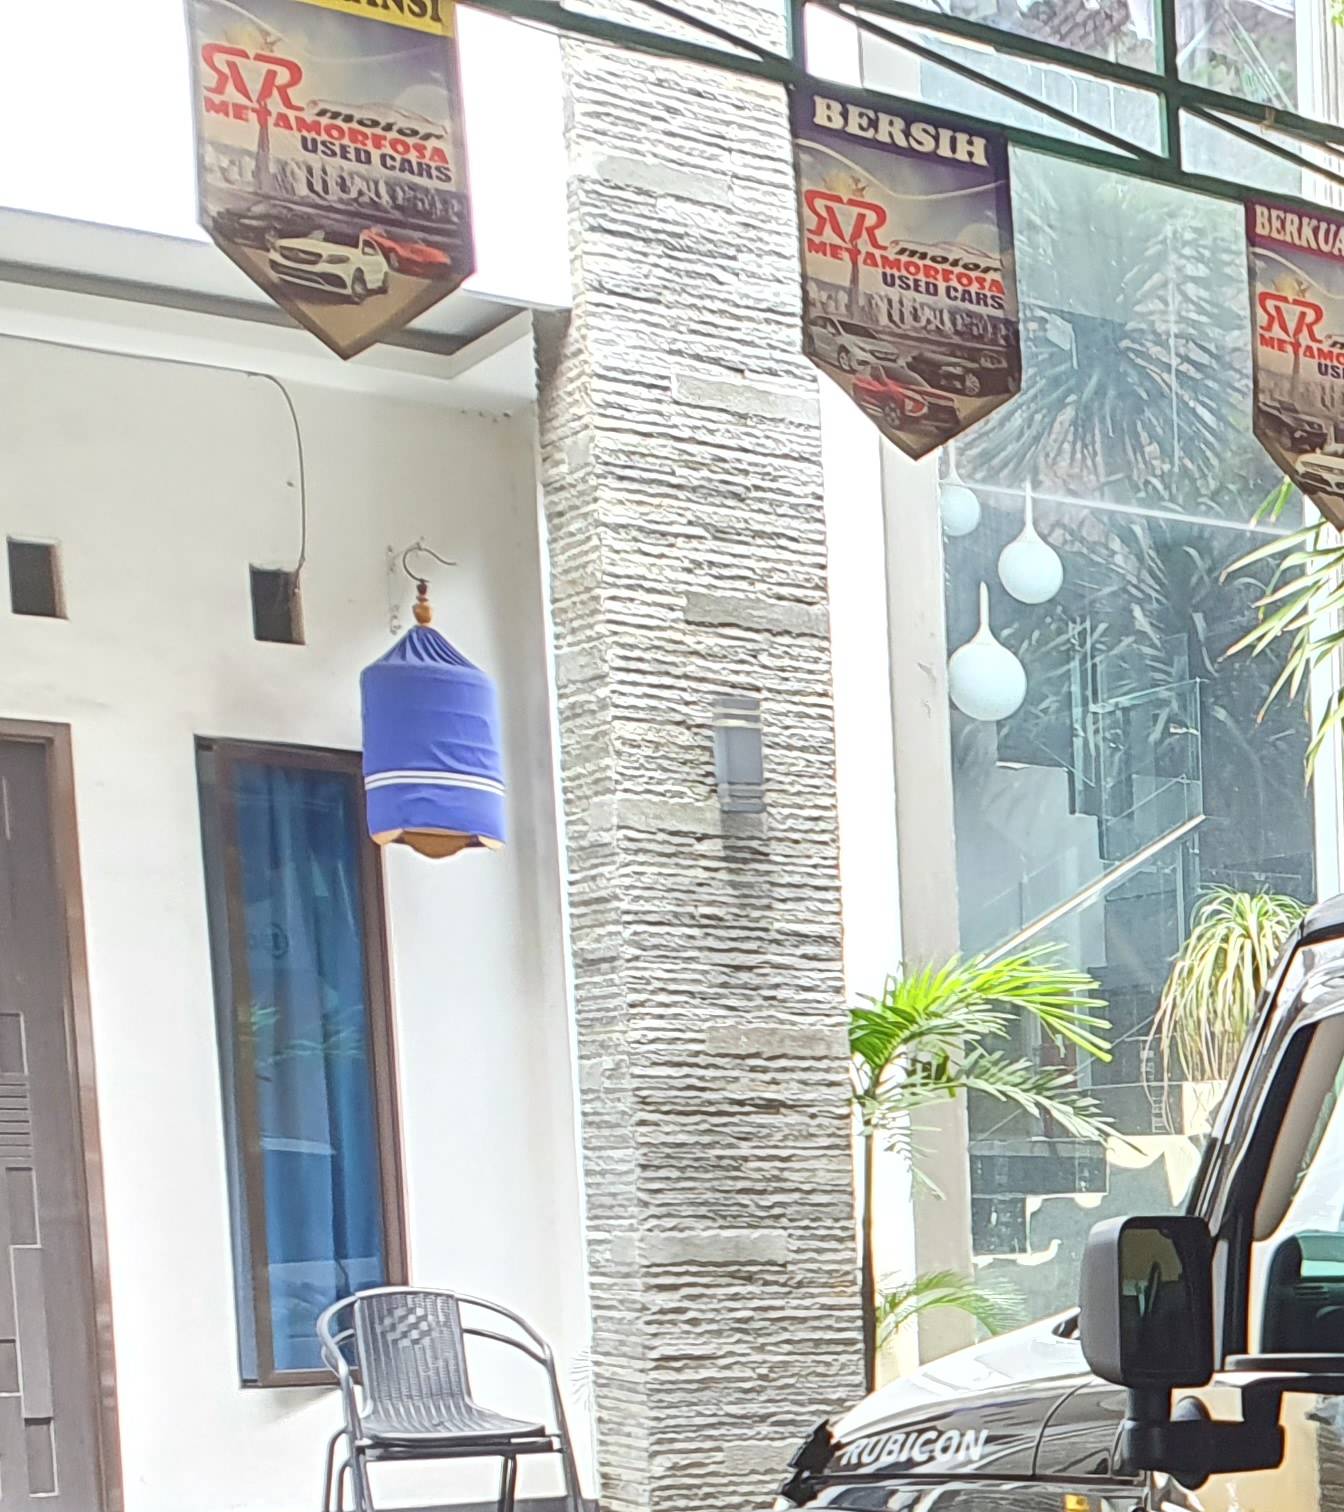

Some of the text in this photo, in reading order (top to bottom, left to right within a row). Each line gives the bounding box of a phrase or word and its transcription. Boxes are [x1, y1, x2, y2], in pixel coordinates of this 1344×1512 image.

[203, 95, 450, 165] METAMORFOSA
[314, 106, 446, 141] motor
[812, 95, 988, 167] BERSIH
[300, 135, 453, 183] USED CARS
[806, 237, 1006, 295] METAMORFOSA
[895, 244, 1001, 274] motor
[881, 270, 1005, 311] USED CARS
[840, 1428, 989, 1466] RUBICON
